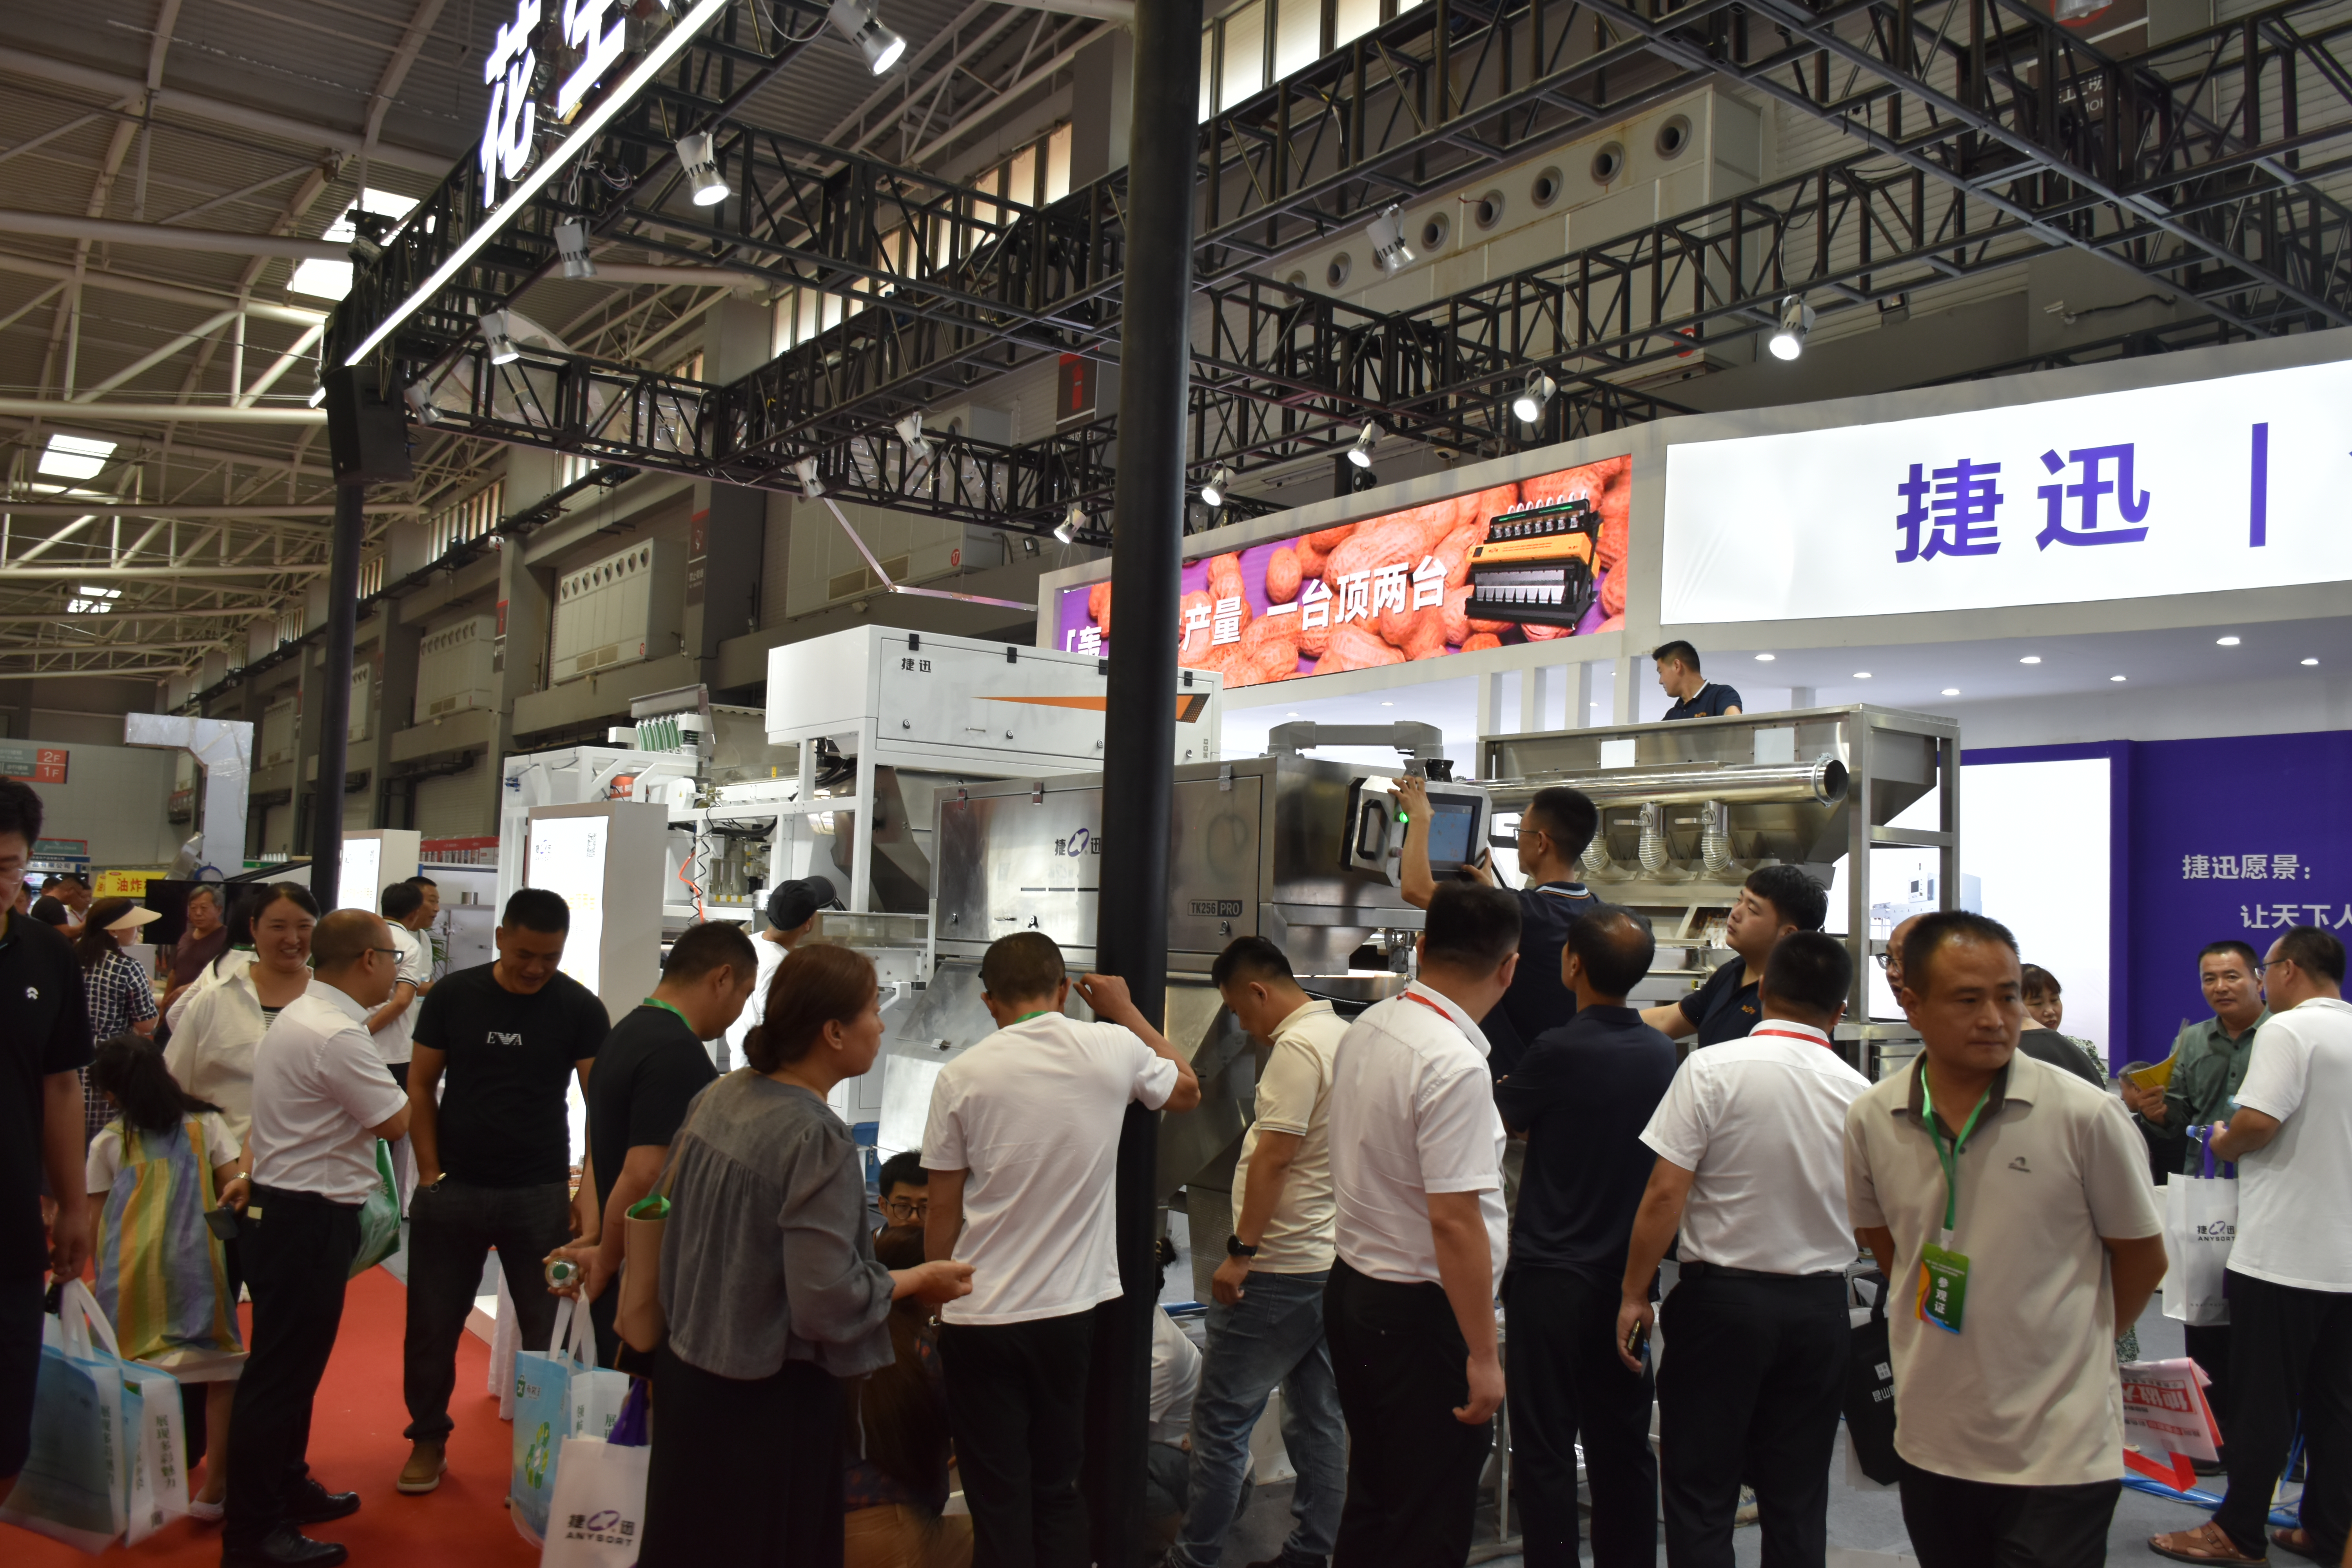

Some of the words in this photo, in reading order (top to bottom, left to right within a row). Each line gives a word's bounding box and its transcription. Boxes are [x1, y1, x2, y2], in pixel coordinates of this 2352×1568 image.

[1895, 442, 2151, 564] 捷迅
[1267, 555, 1448, 631] 一台顶两台
[901, 657, 931, 673] 捷迅
[44, 751, 60, 762] 2F
[44, 766, 59, 777] 1F
[2182, 854, 2310, 880] 捷迅愿景：
[117, 878, 147, 892] 油炸
[1191, 902, 1216, 914] TK256
[1220, 902, 1240, 915] PRO
[1934, 1277, 1949, 1314] 参观证
